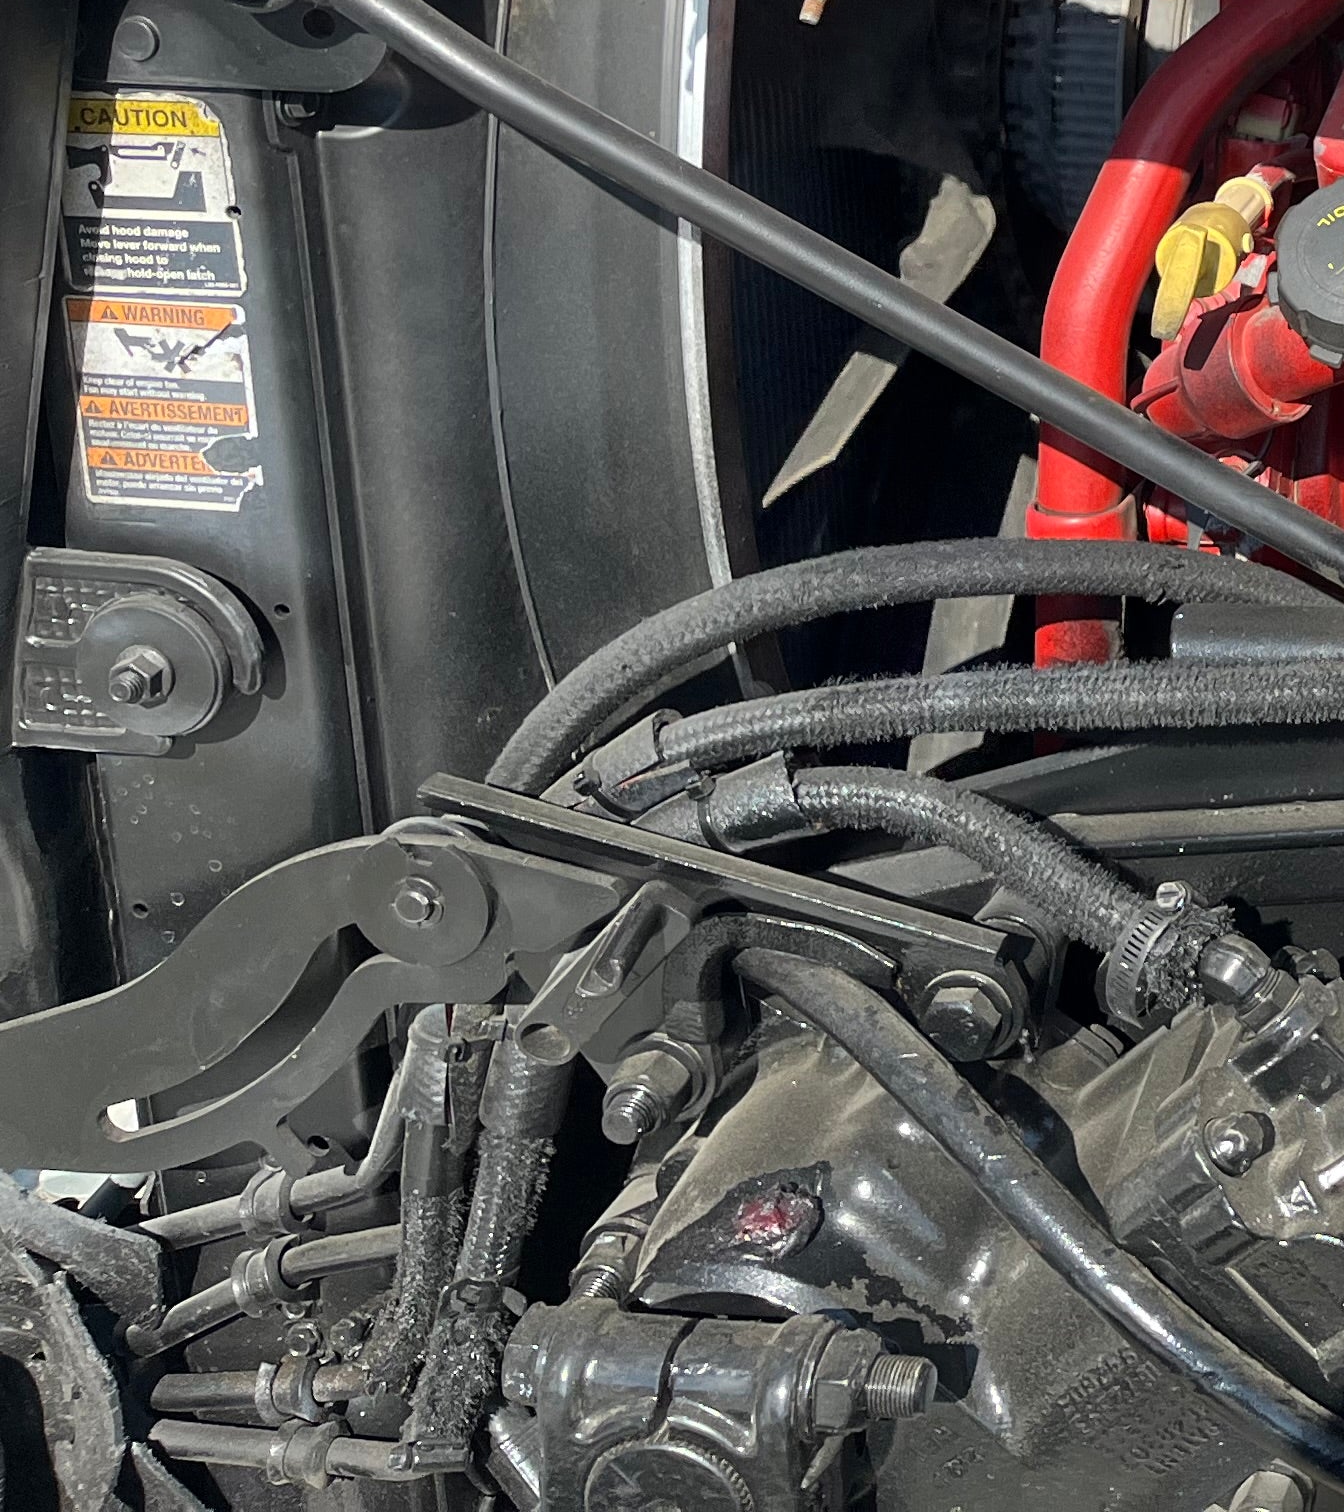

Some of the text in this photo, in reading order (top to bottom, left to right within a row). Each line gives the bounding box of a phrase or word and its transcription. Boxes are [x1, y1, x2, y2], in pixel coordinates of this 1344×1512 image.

[80, 107, 187, 128] CAUTION
[79, 225, 189, 239] Avoid hood damage
[80, 238, 221, 254] Move lever forward when
[82, 253, 169, 265] closing hood to
[127, 268, 185, 284] hold-open
[187, 269, 215, 281] latch
[122, 305, 205, 326] WARNING
[109, 399, 244, 423] AVERTISSEMENT
